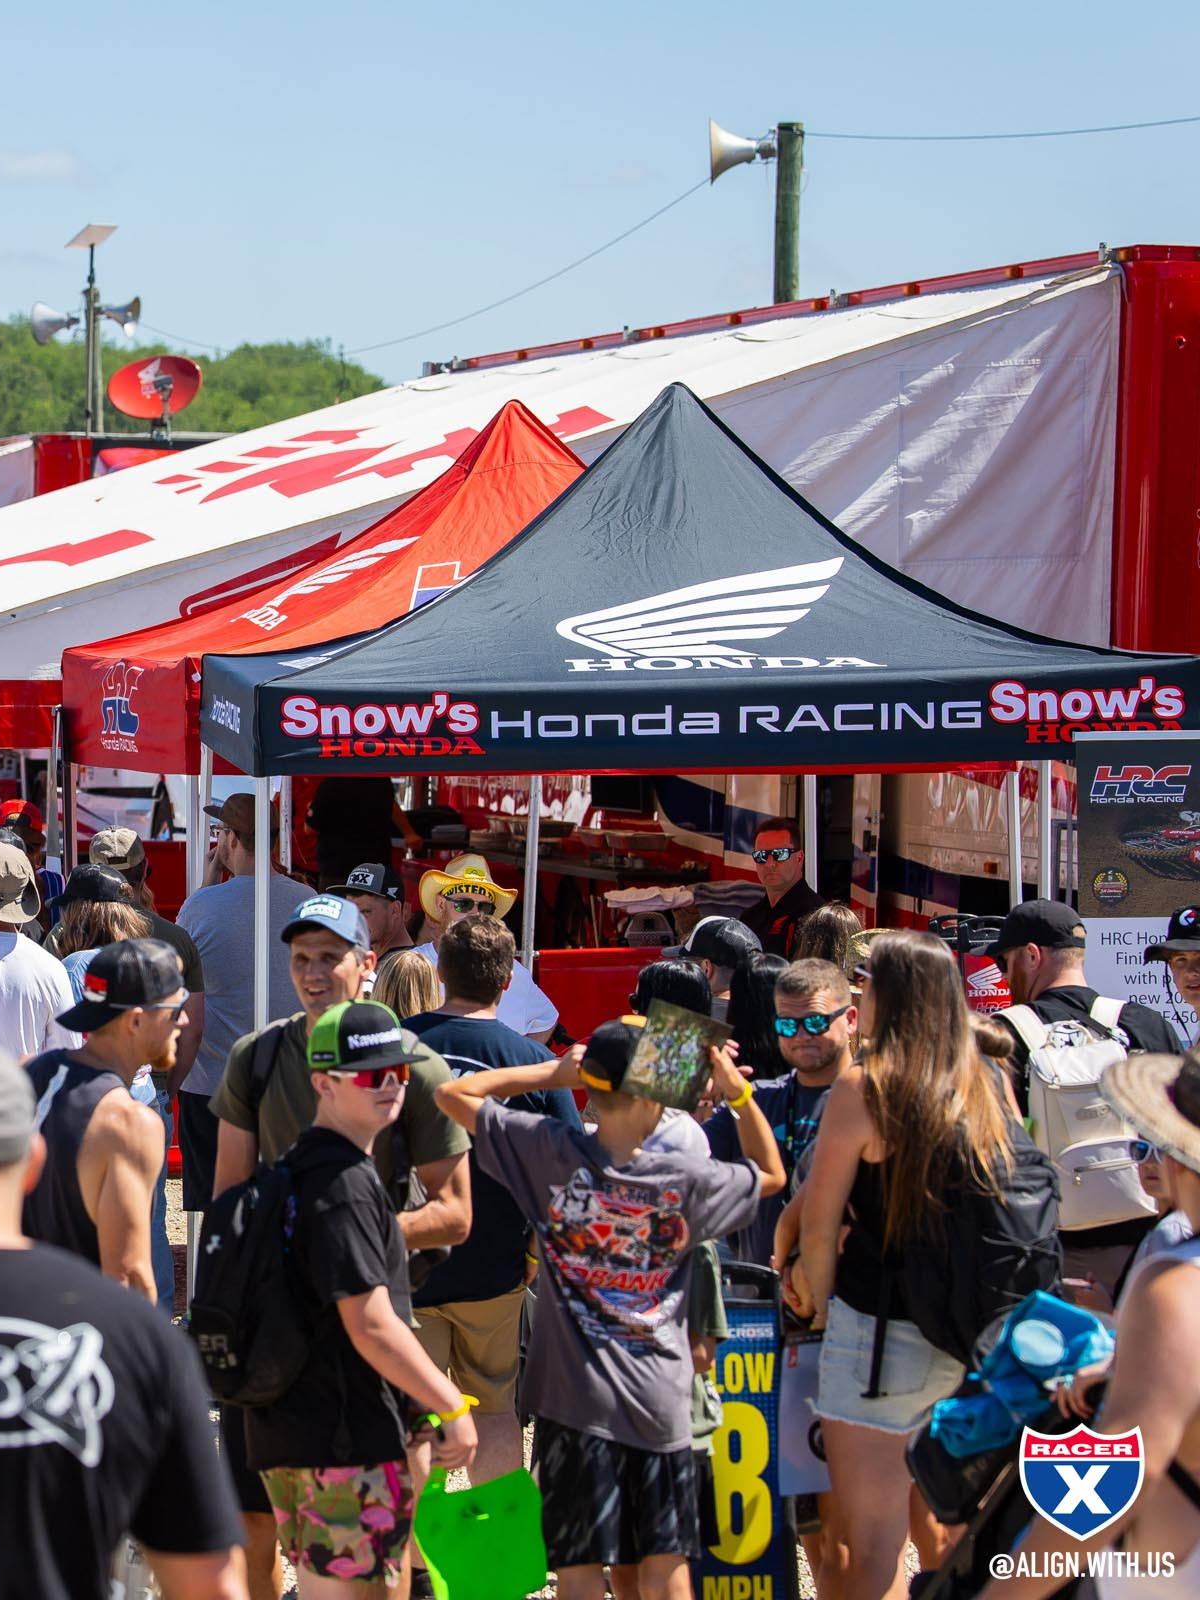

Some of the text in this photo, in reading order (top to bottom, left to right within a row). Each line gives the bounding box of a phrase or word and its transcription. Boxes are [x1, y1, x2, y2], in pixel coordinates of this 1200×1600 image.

[564, 656, 888, 672] HONDA
[280, 676, 1187, 739] Snow's Honda RACING Snow's
[318, 737, 486, 759] HONDA
[1090, 765, 1192, 797] HRC
[1090, 795, 1184, 804] Honda RACING
[1101, 931, 1132, 945] HRC
[1124, 971, 1157, 985] with
[1129, 994, 1161, 1005] new
[709, 1401, 772, 1565] 8
[702, 1575, 772, 1600] MPH
